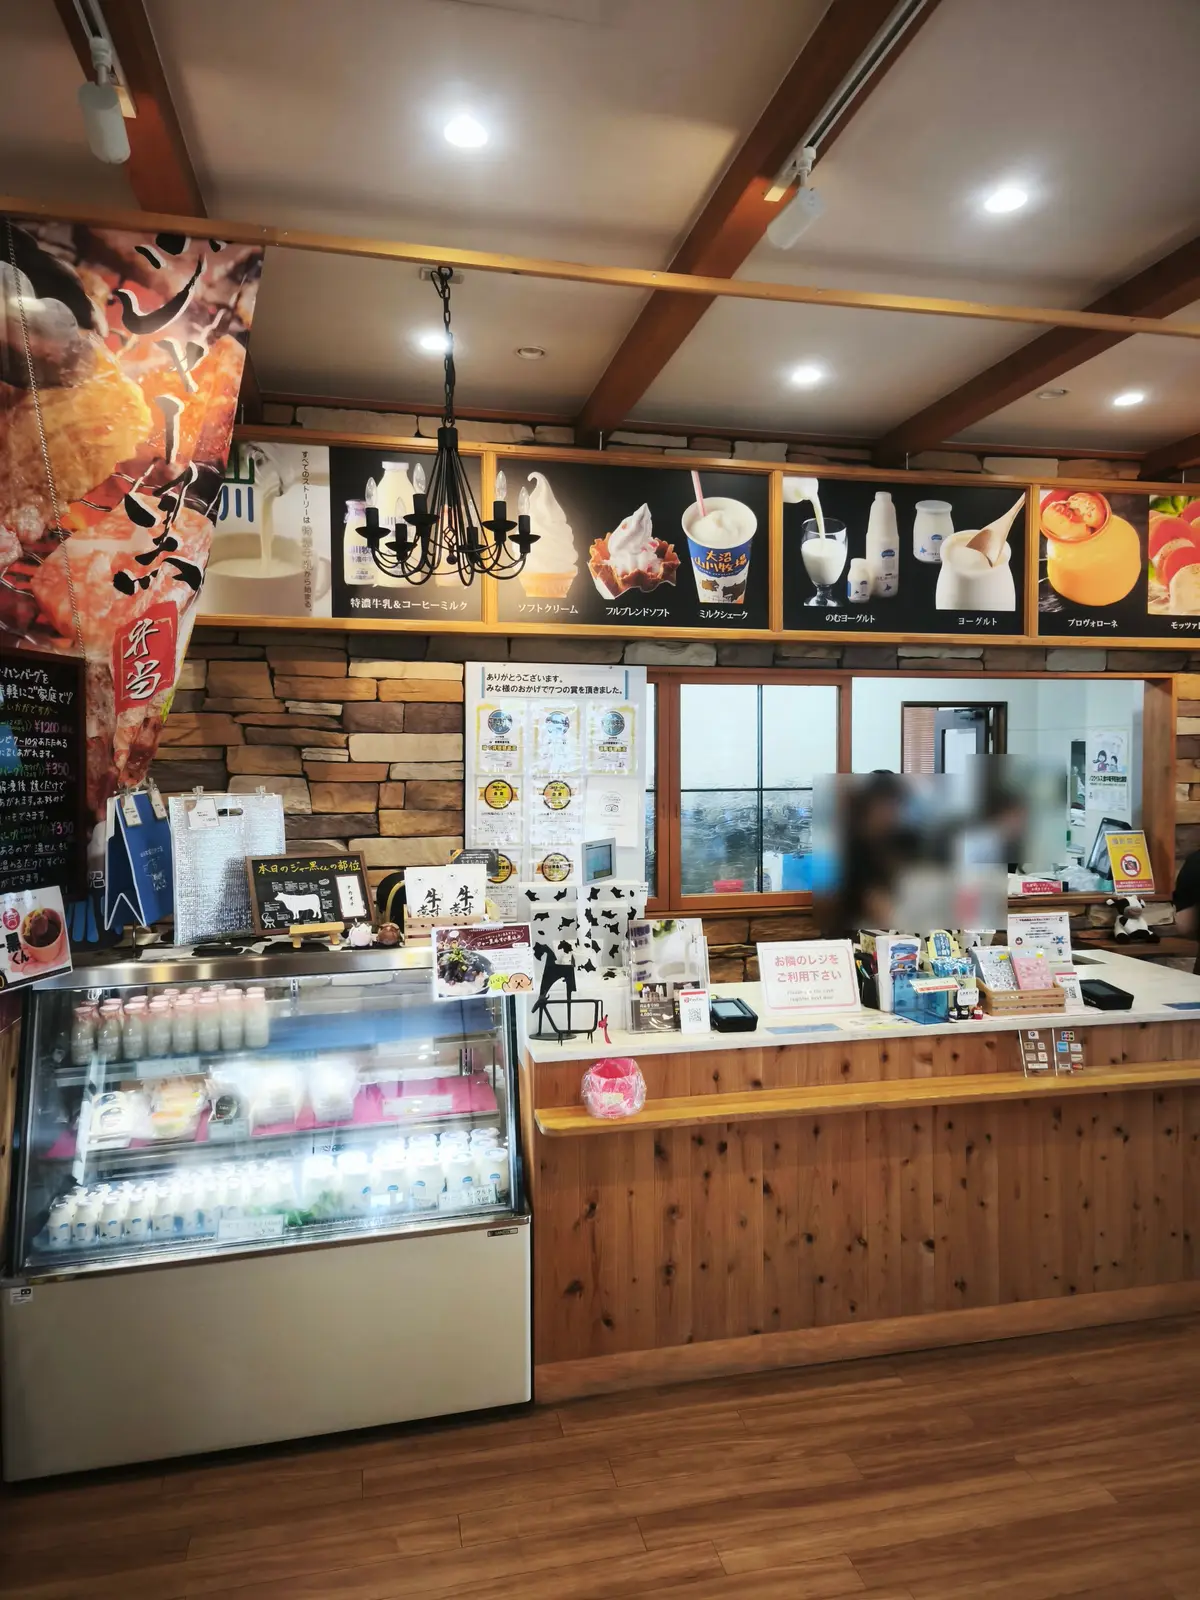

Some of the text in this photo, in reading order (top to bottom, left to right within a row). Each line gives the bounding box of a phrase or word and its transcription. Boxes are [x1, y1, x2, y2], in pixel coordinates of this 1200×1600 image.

[350, 598, 468, 611] 特濃牛乳&コーヒーミルク
[517, 603, 579, 614] ソフトクリーム
[605, 606, 670, 617] フルブレンドソフト
[699, 609, 748, 619] ミルクシェーク
[825, 613, 876, 623] のむヨーグルト
[957, 617, 998, 626] ヨーグルト
[124, 617, 162, 700] 弁当
[486, 673, 563, 683] ありがとうございます。
[486, 684, 623, 695] みな様のおかげで7つの賞を頂きました。
[258, 859, 361, 875] 本日のジャー黒くんの部位
[774, 954, 839, 967] お隣のレジを
[777, 970, 842, 983] ご利用下さい
